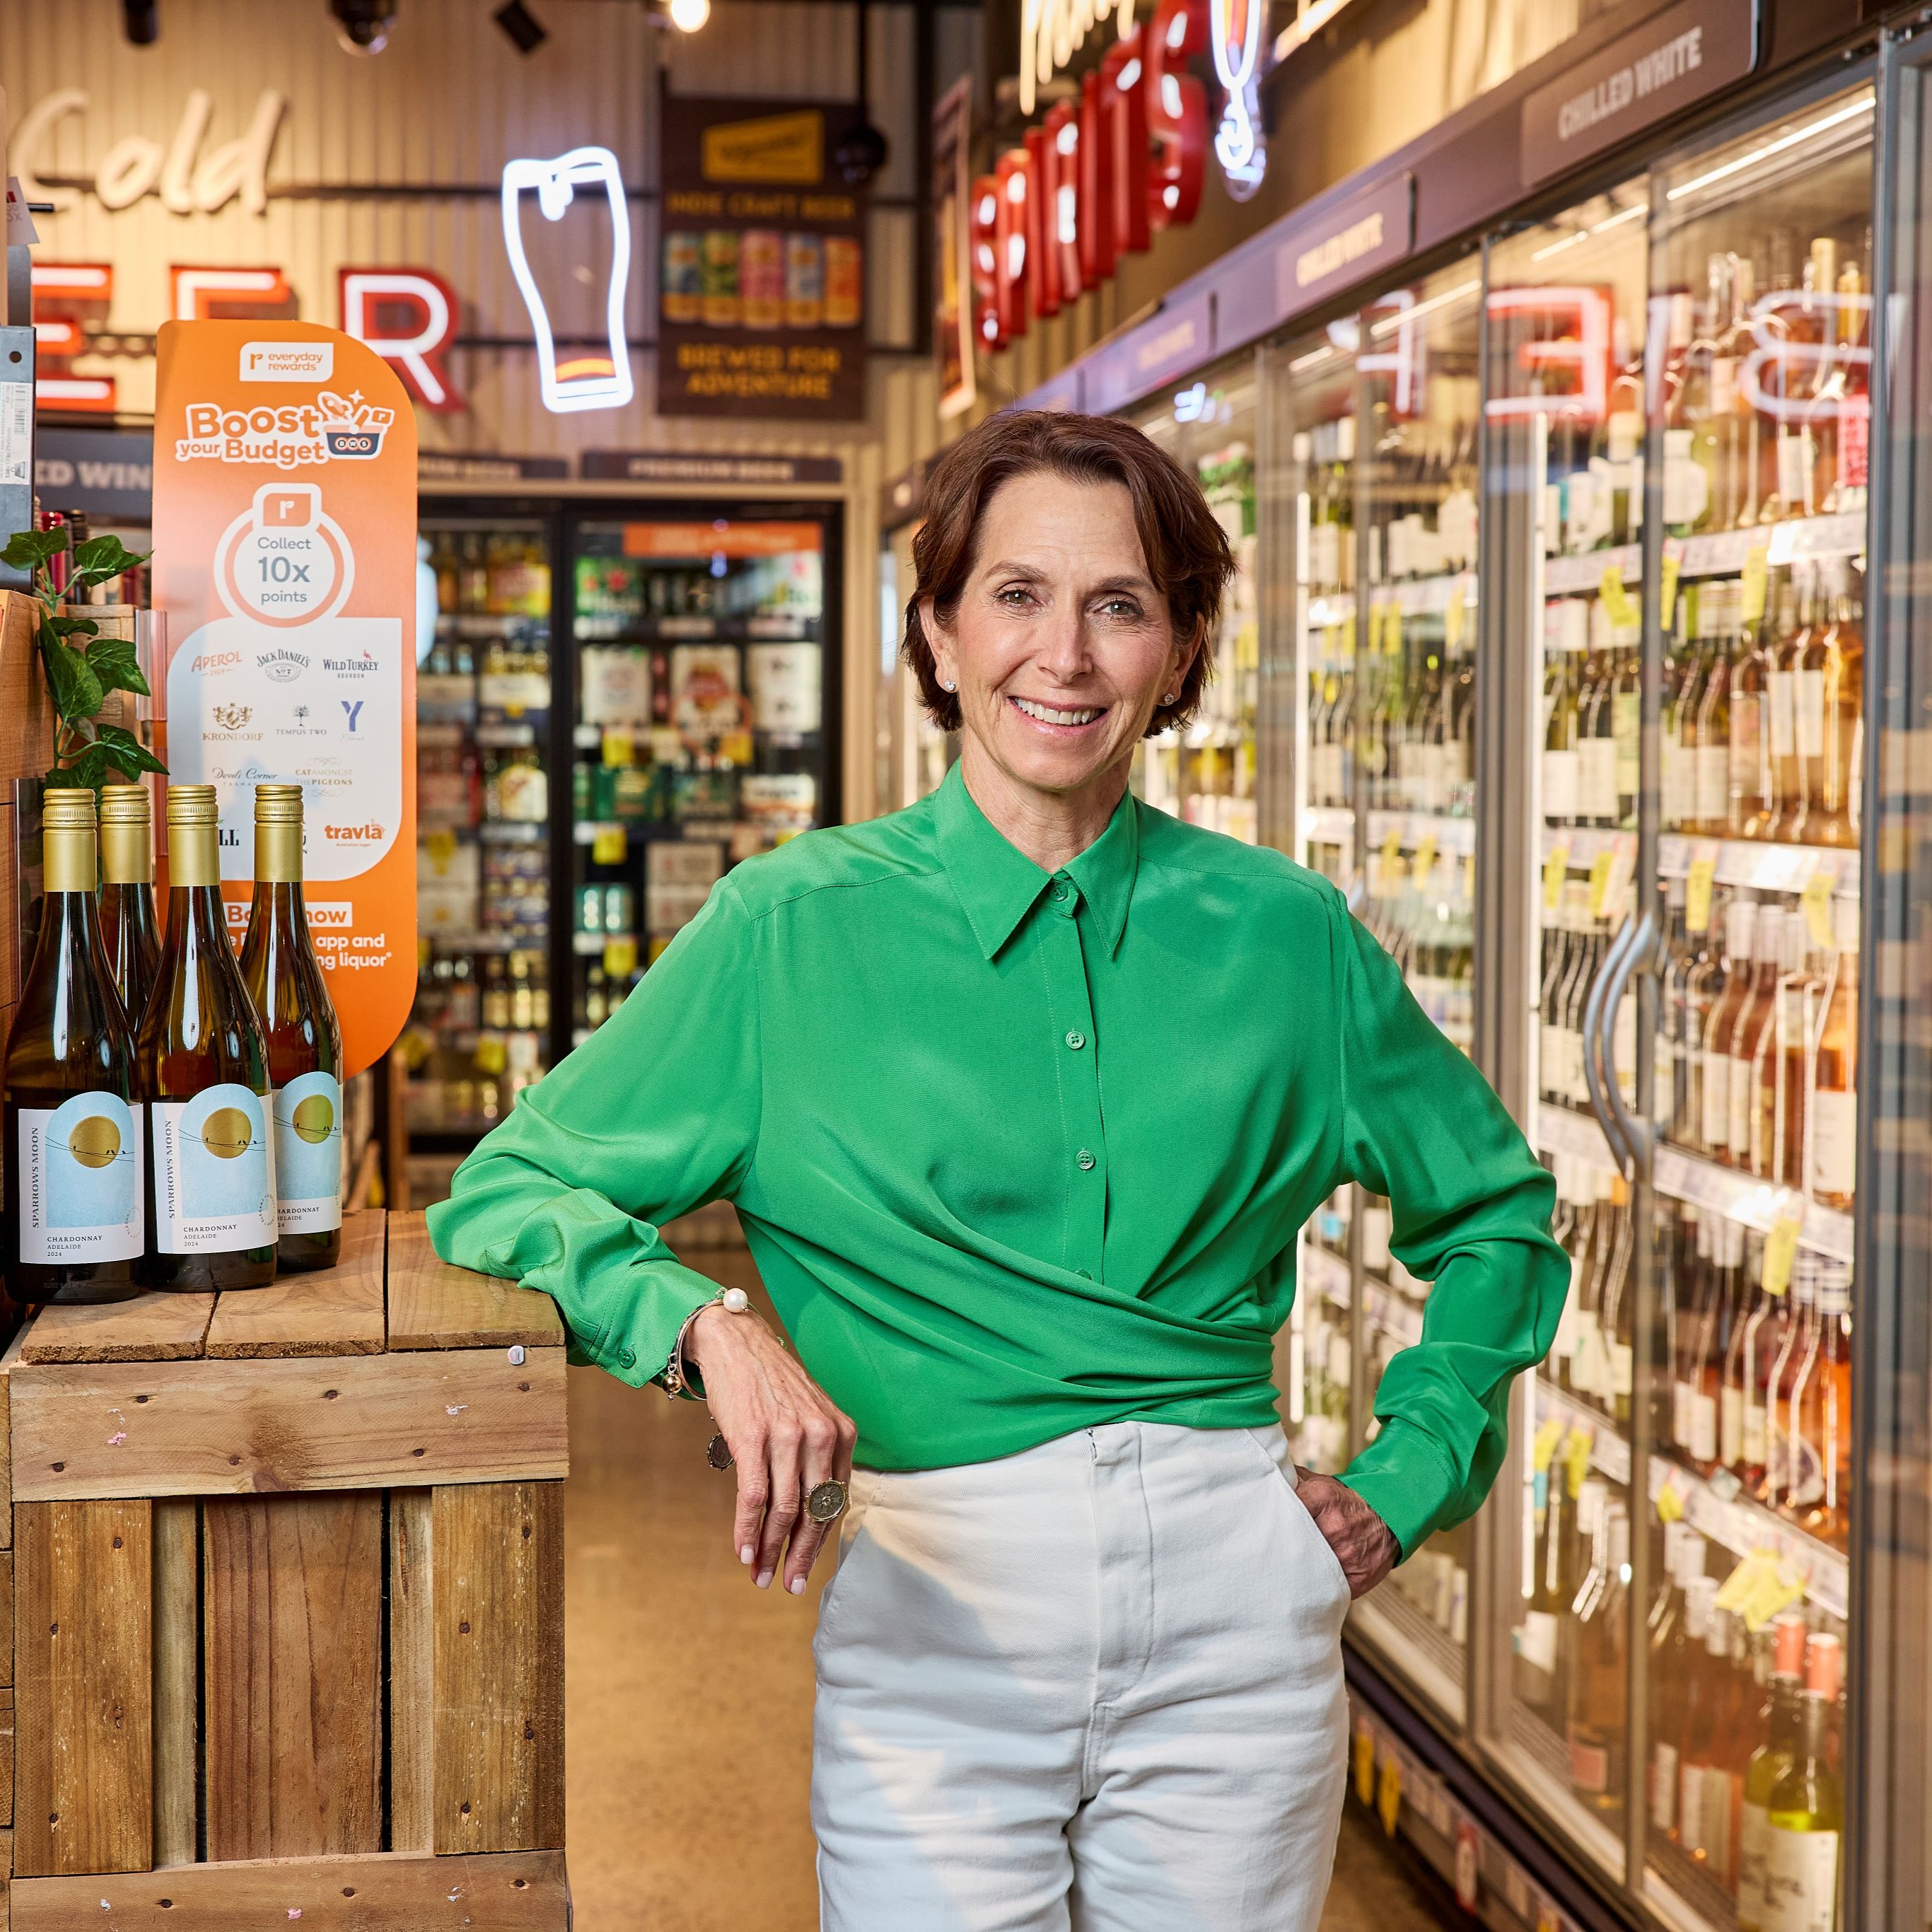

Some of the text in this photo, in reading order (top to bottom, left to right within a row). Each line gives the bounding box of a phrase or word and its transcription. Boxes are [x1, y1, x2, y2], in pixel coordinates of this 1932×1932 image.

[1559, 26, 1702, 141] CHILLED WHITE
[10, 88, 284, 214] Cold
[268, 352, 323, 363] everyday
[268, 362, 316, 371] rewards
[190, 407, 320, 439] Boost
[180, 439, 325, 464] your Budget
[35, 460, 75, 489] ED
[76, 461, 152, 494] WIN
[257, 537, 311, 549] Collect
[257, 556, 310, 583] 10x
[261, 590, 308, 605] points
[192, 650, 243, 673] APEROL
[256, 648, 311, 668] JACK DANIEL'S
[322, 659, 379, 672] WILD TURKEY
[340, 701, 364, 732] Y
[202, 733, 264, 741] KRONDORF
[245, 767, 279, 779] Corner
[325, 825, 383, 839] travla
[316, 933, 385, 951] app and
[167, 1158, 175, 1219] SPARROWS
[183, 1224, 238, 1233] CHARDONNAY
